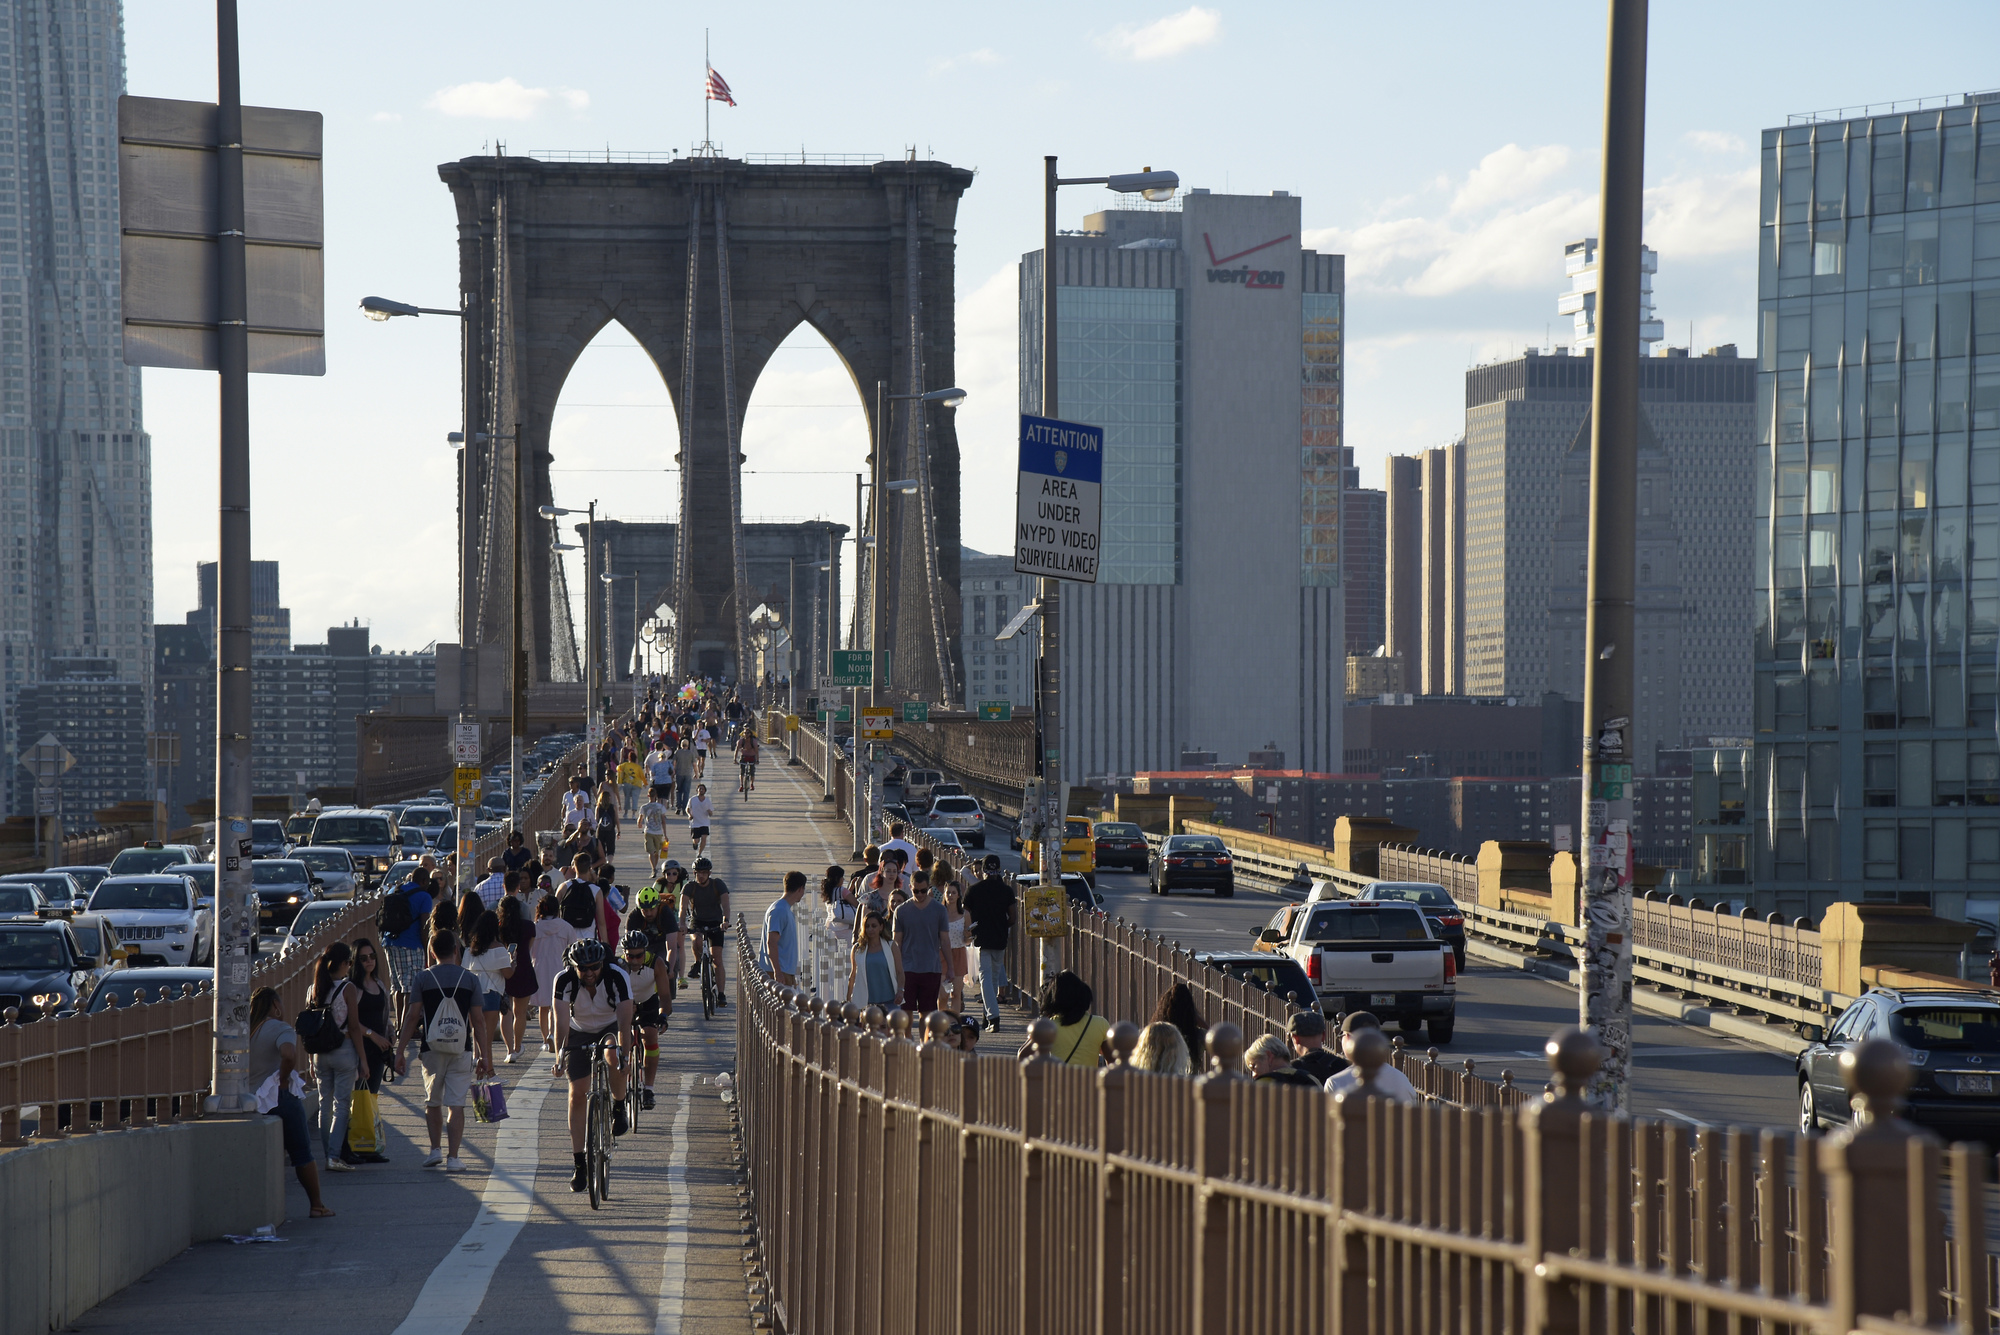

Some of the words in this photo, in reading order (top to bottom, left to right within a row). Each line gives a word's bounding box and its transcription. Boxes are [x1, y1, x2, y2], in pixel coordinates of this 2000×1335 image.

[1207, 265, 1285, 289] verizon
[1026, 424, 1098, 452] ATTENTION
[1041, 478, 1078, 500] AREA
[1038, 501, 1080, 524] UNDER
[1020, 523, 1056, 544] NYPD
[1061, 529, 1097, 551] VIDEO
[1019, 547, 1095, 575] SURVEILLANCE
[848, 653, 862, 661] FDR
[834, 676, 855, 684] RIGHT
[858, 675, 863, 684] 2
[458, 772, 477, 780] BIKES
[462, 782, 472, 790] GO
[1612, 785, 1620, 797] 2
